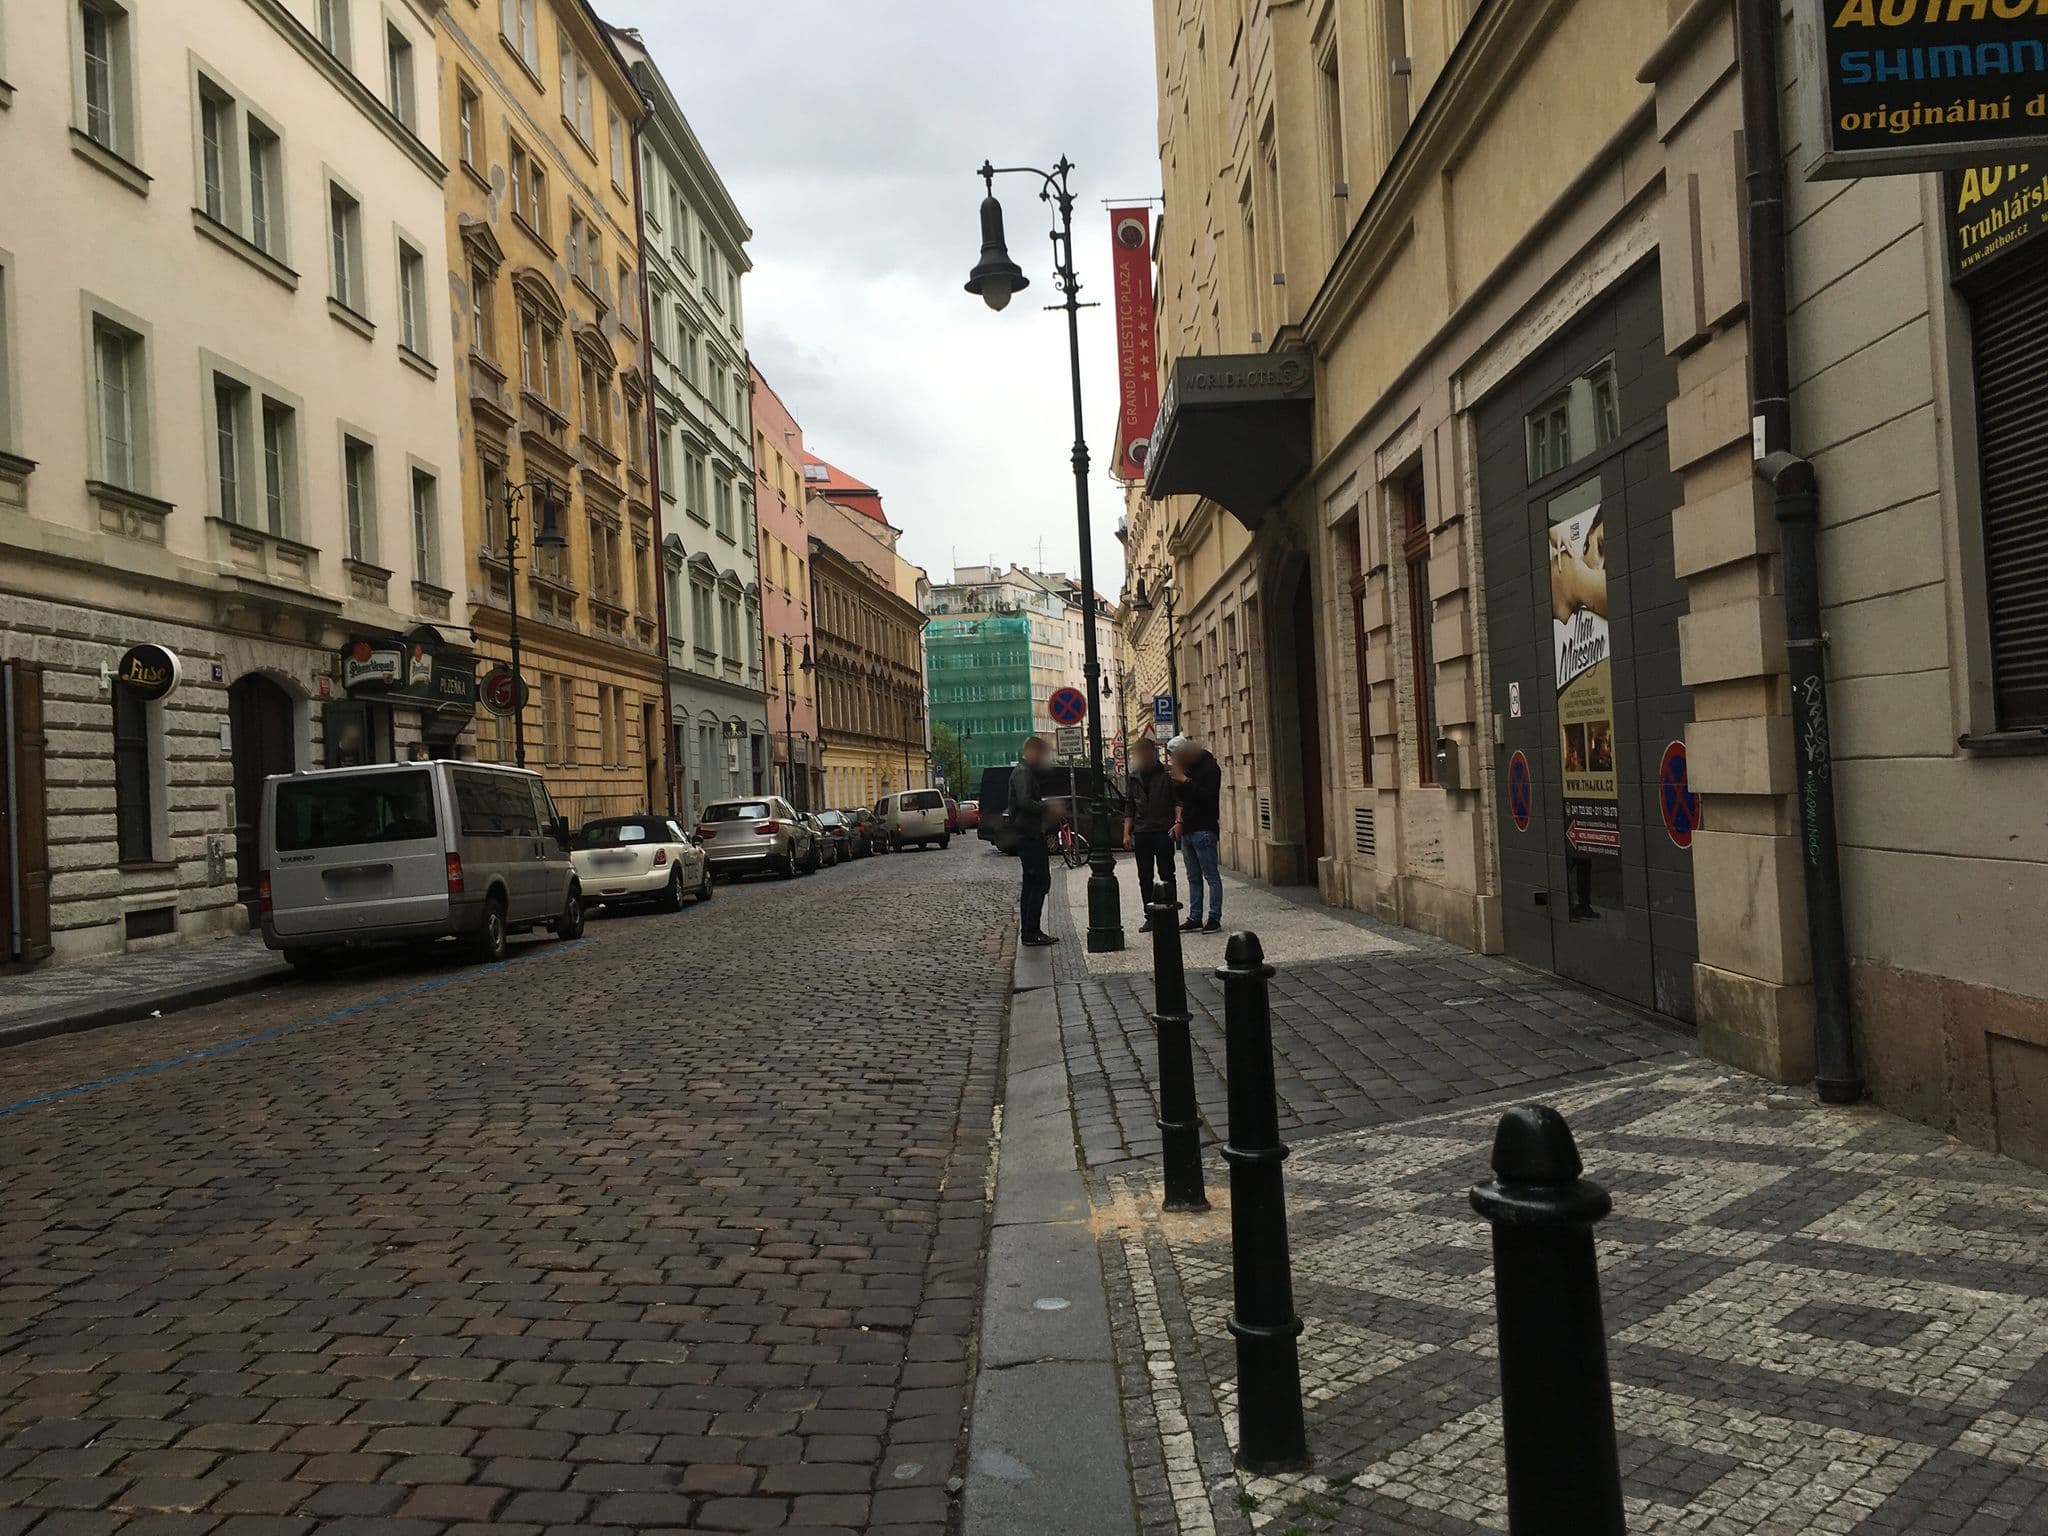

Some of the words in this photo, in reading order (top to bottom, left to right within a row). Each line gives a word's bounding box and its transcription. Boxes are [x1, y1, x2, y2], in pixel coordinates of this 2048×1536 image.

[1832, 0, 2048, 28] AUTHO
[1840, 40, 2048, 84] SHIMAN
[1840, 95, 2010, 134] originální
[1960, 222, 2030, 270] www.author.cz
[1119, 261, 1131, 303] PLAZA
[1120, 305, 1137, 378] MAJESTIC
[1126, 381, 1138, 426] GRAND
[127, 657, 168, 682] Fuse
[1157, 698, 1170, 715] P
